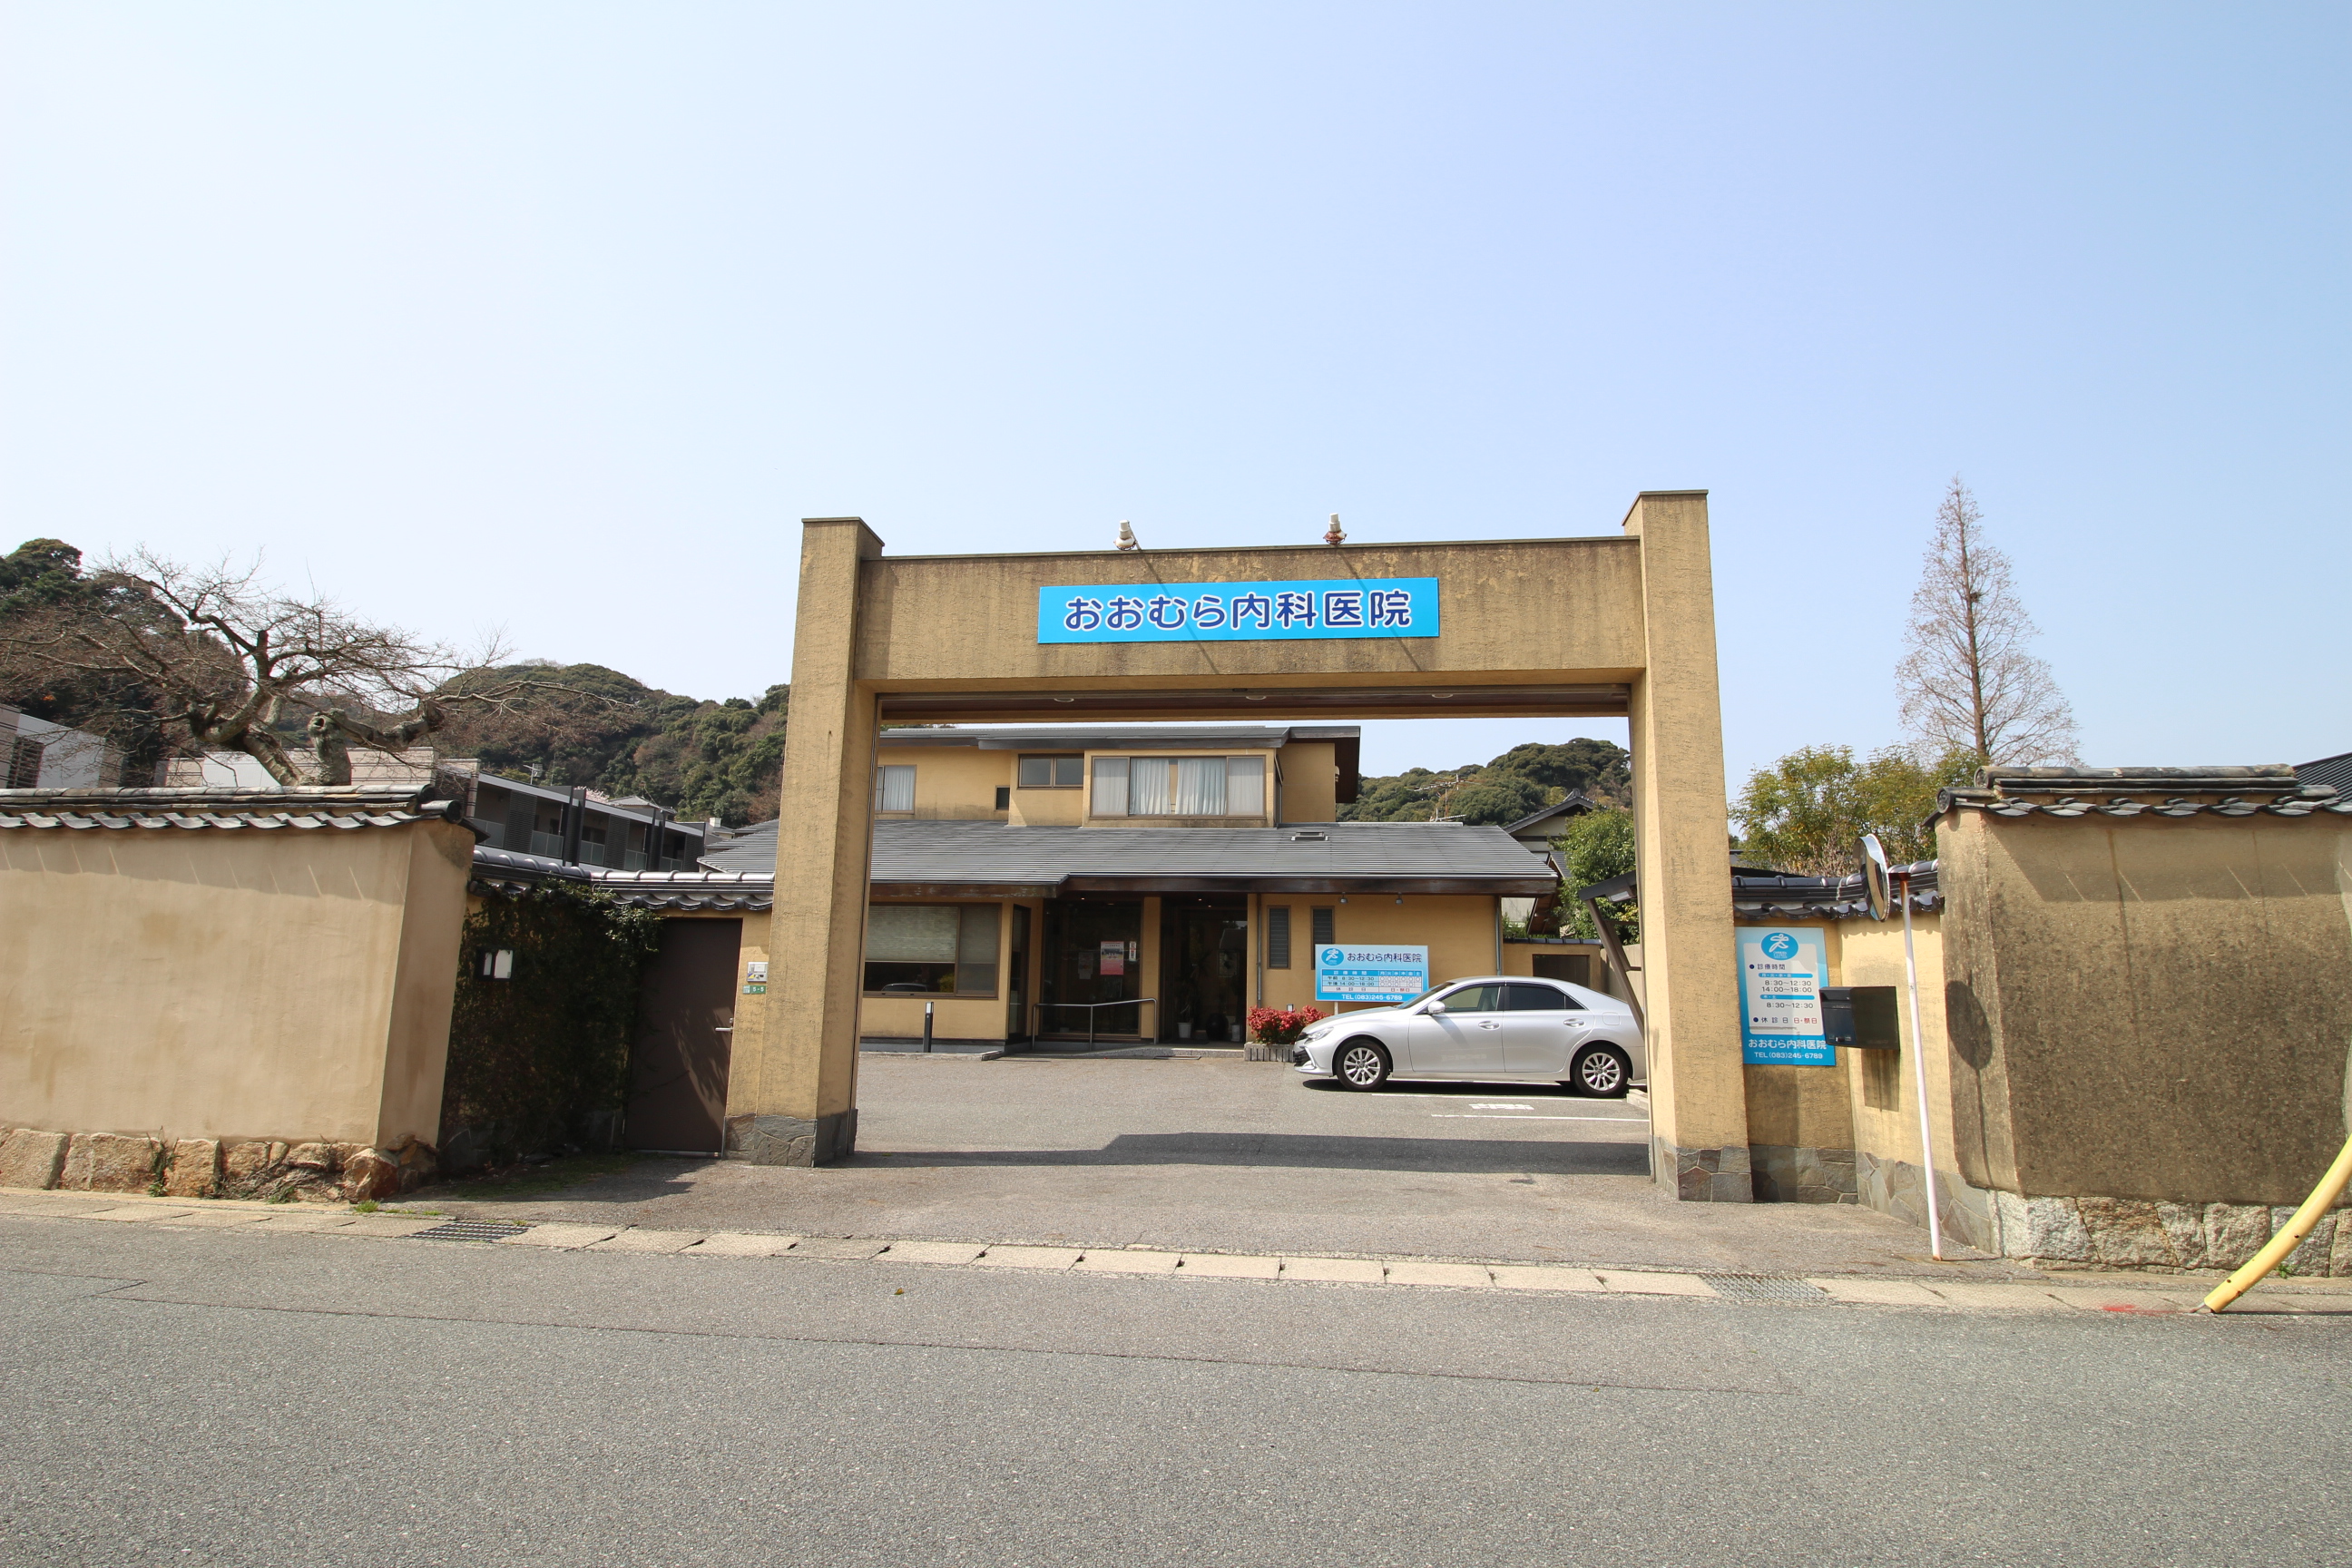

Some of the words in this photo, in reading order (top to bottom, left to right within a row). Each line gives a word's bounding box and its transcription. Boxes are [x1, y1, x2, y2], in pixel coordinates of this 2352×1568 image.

[1064, 590, 1412, 631] おおむら内科医院
[1348, 953, 1422, 962] おおむら内科医院
[1748, 1039, 1828, 1050] おおむら内科医院
